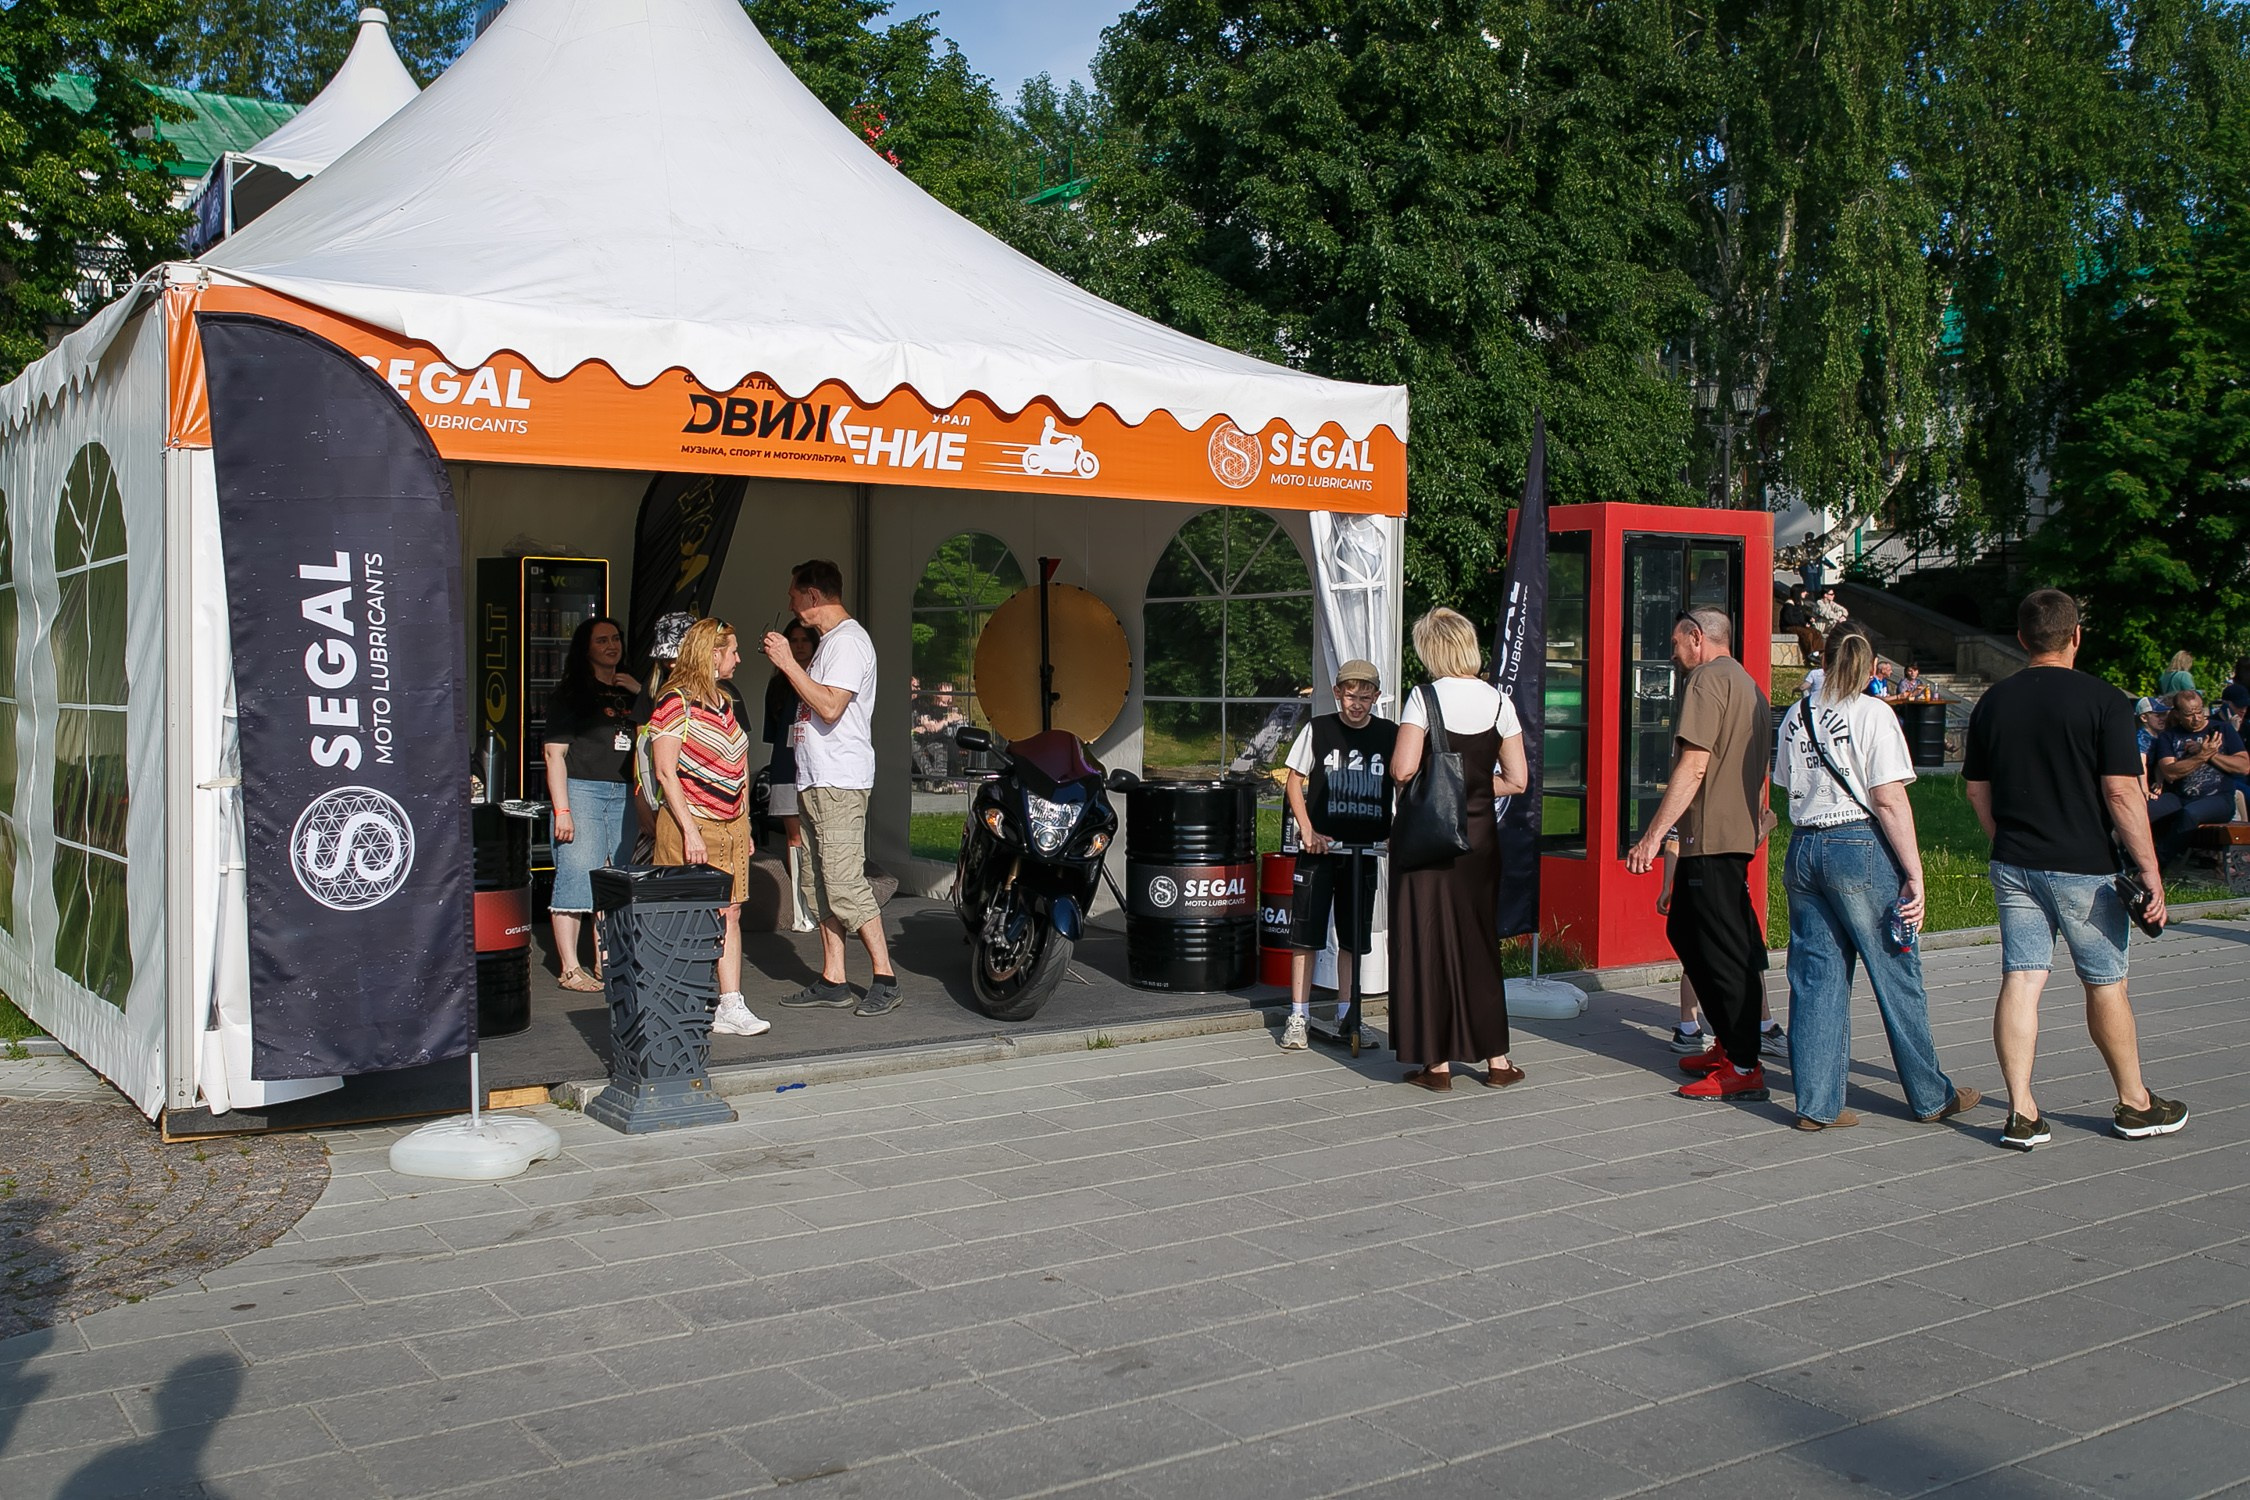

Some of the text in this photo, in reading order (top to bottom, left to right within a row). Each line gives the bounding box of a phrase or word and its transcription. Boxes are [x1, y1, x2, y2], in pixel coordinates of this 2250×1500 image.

[420, 413, 528, 434] UBRICANTS
[931, 413, 971, 427] УРАЛ
[681, 444, 847, 464] МУЗЫКА, СПОРТ И МОТОКУЛЬТУРА
[1268, 432, 1375, 472] SEGAL
[1270, 473, 1373, 491] MOTO LUBRICANTS
[299, 550, 363, 771] SEGAL
[364, 552, 394, 765] MOTO LUBRICANTS
[1819, 708, 1851, 747] FIVE
[1327, 799, 1383, 817] BORDER
[1824, 808, 1862, 820] PERFECTIO
[1183, 877, 1247, 898] SEGAL
[1184, 898, 1246, 908] MOTO LUBRICANTS
[1260, 906, 1292, 925] EGA
